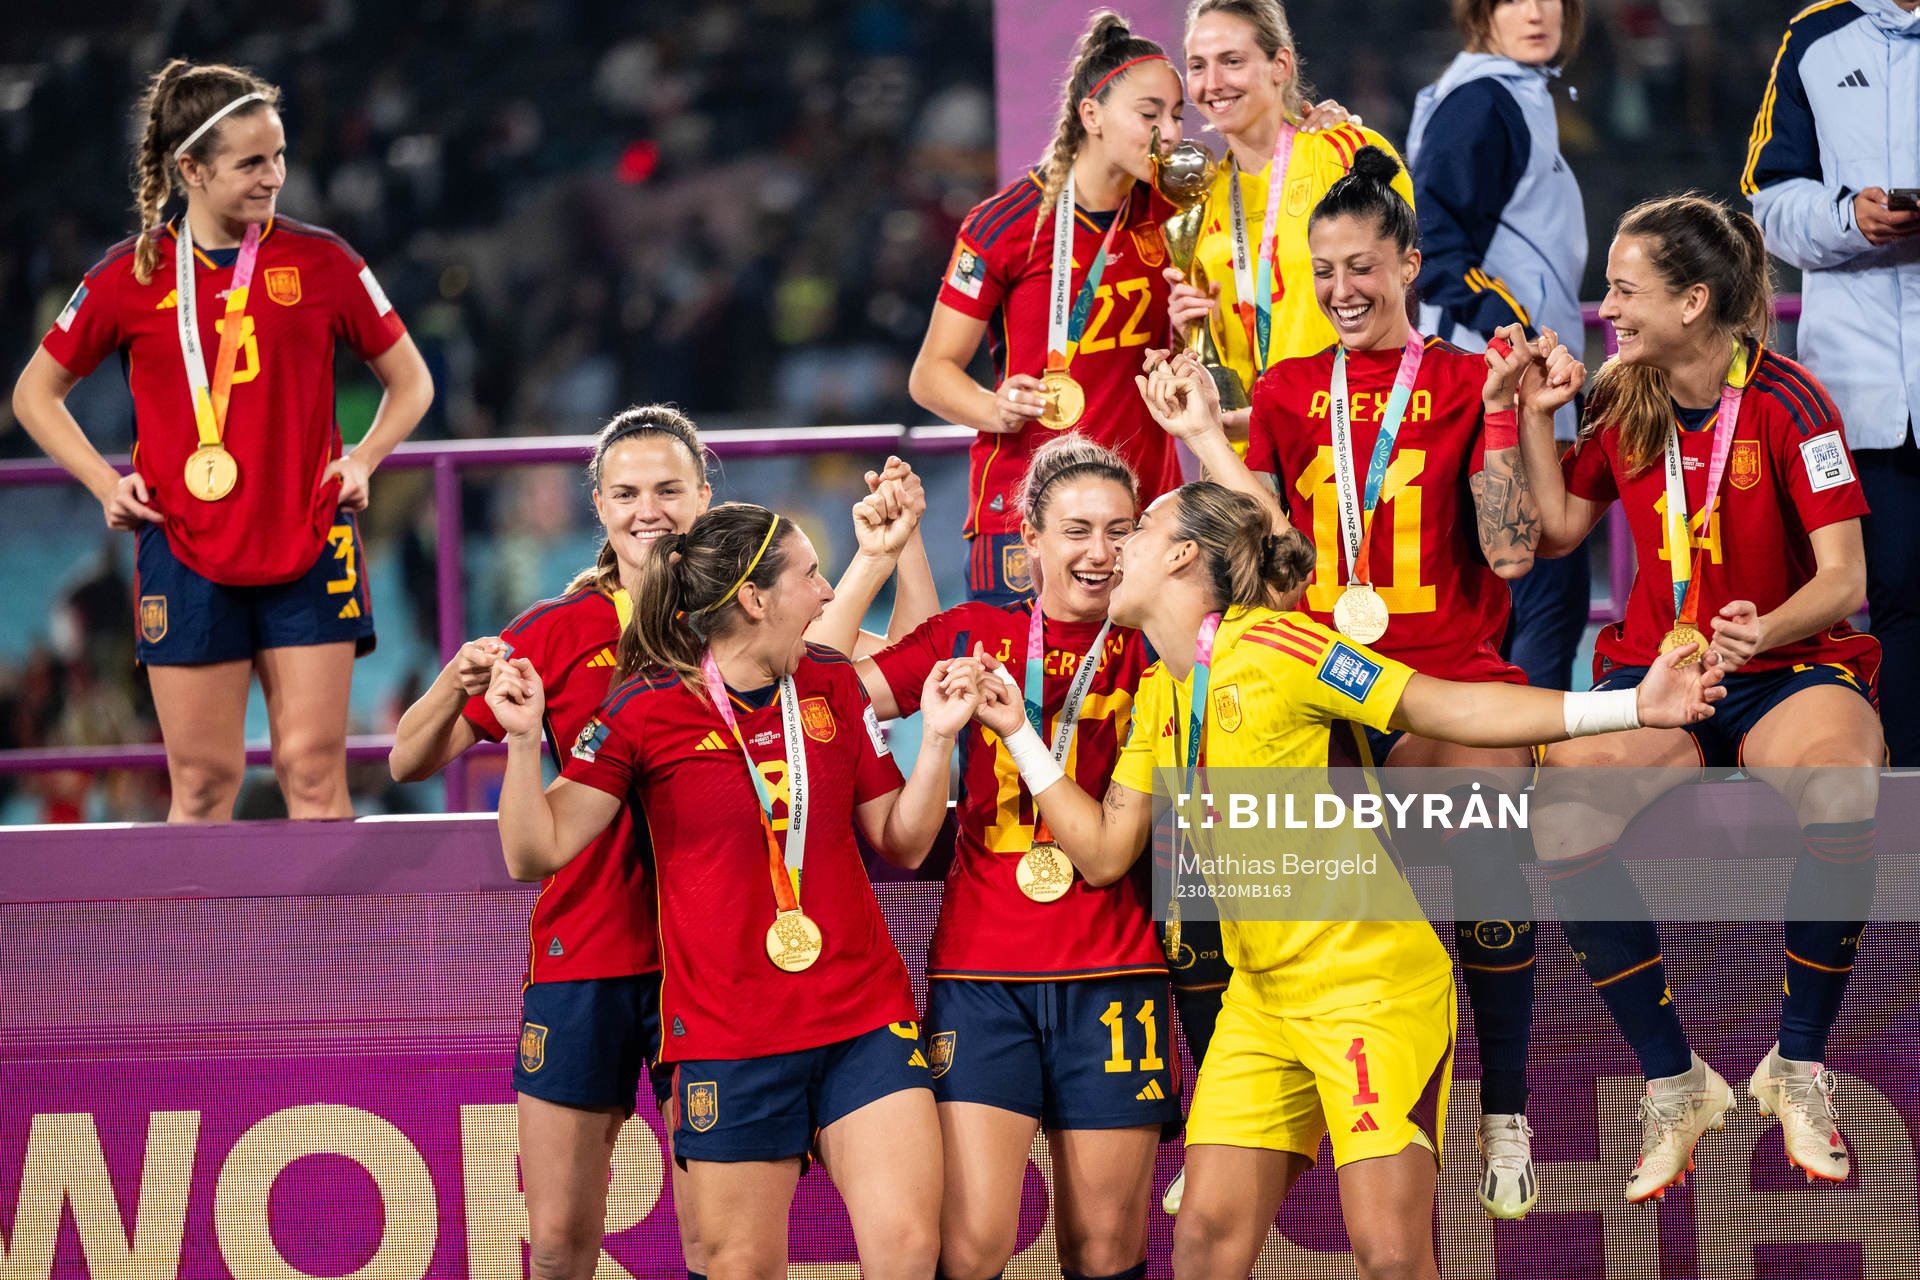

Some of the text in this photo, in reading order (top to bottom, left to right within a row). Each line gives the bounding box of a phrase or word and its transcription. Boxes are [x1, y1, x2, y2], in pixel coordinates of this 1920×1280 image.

[1078, 277, 1152, 355] 22
[1340, 453, 1350, 483] WORLD
[1814, 448, 1840, 464] UNITES
[1343, 483, 1352, 501] CUP
[327, 525, 357, 595] 3
[1296, 445, 1437, 615] 11
[1653, 490, 1723, 565] 14
[789, 724, 800, 754] WORLD
[793, 754, 801, 772] CUP
[1100, 1000, 1165, 1073] 11
[1340, 1038, 1379, 1106] 1
